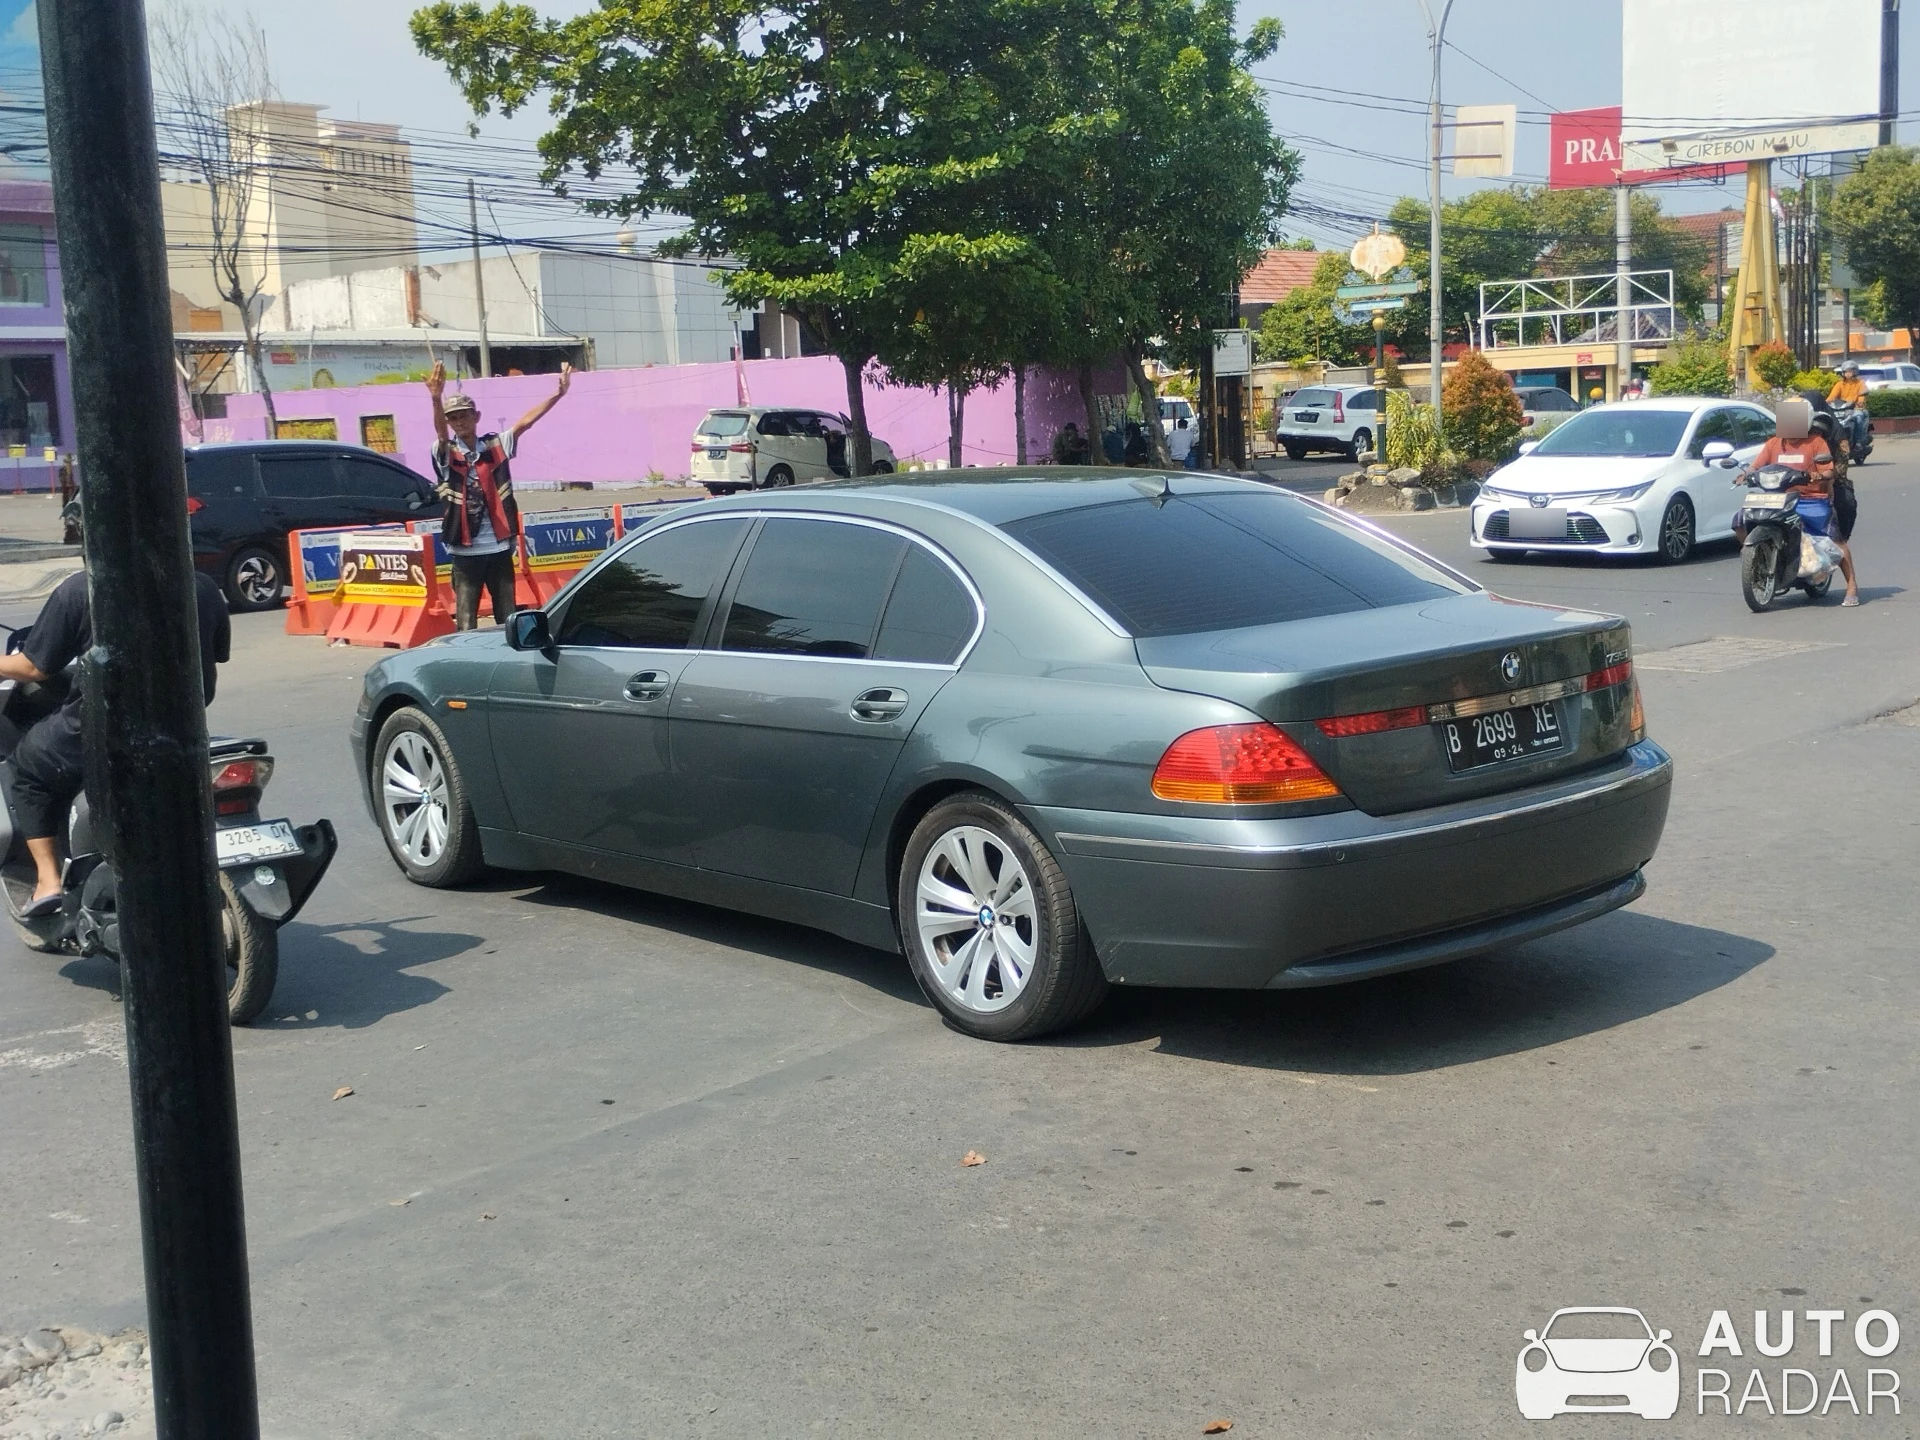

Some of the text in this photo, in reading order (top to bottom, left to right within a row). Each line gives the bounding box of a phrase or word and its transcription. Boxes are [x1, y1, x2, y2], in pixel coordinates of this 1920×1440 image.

[1687, 139, 1755, 159] CIREBON
[546, 526, 596, 544] VIVIAN
[357, 553, 409, 571] PANTES
[1447, 701, 1557, 754] B 2699 XE
[225, 823, 290, 846] 3285 DK
